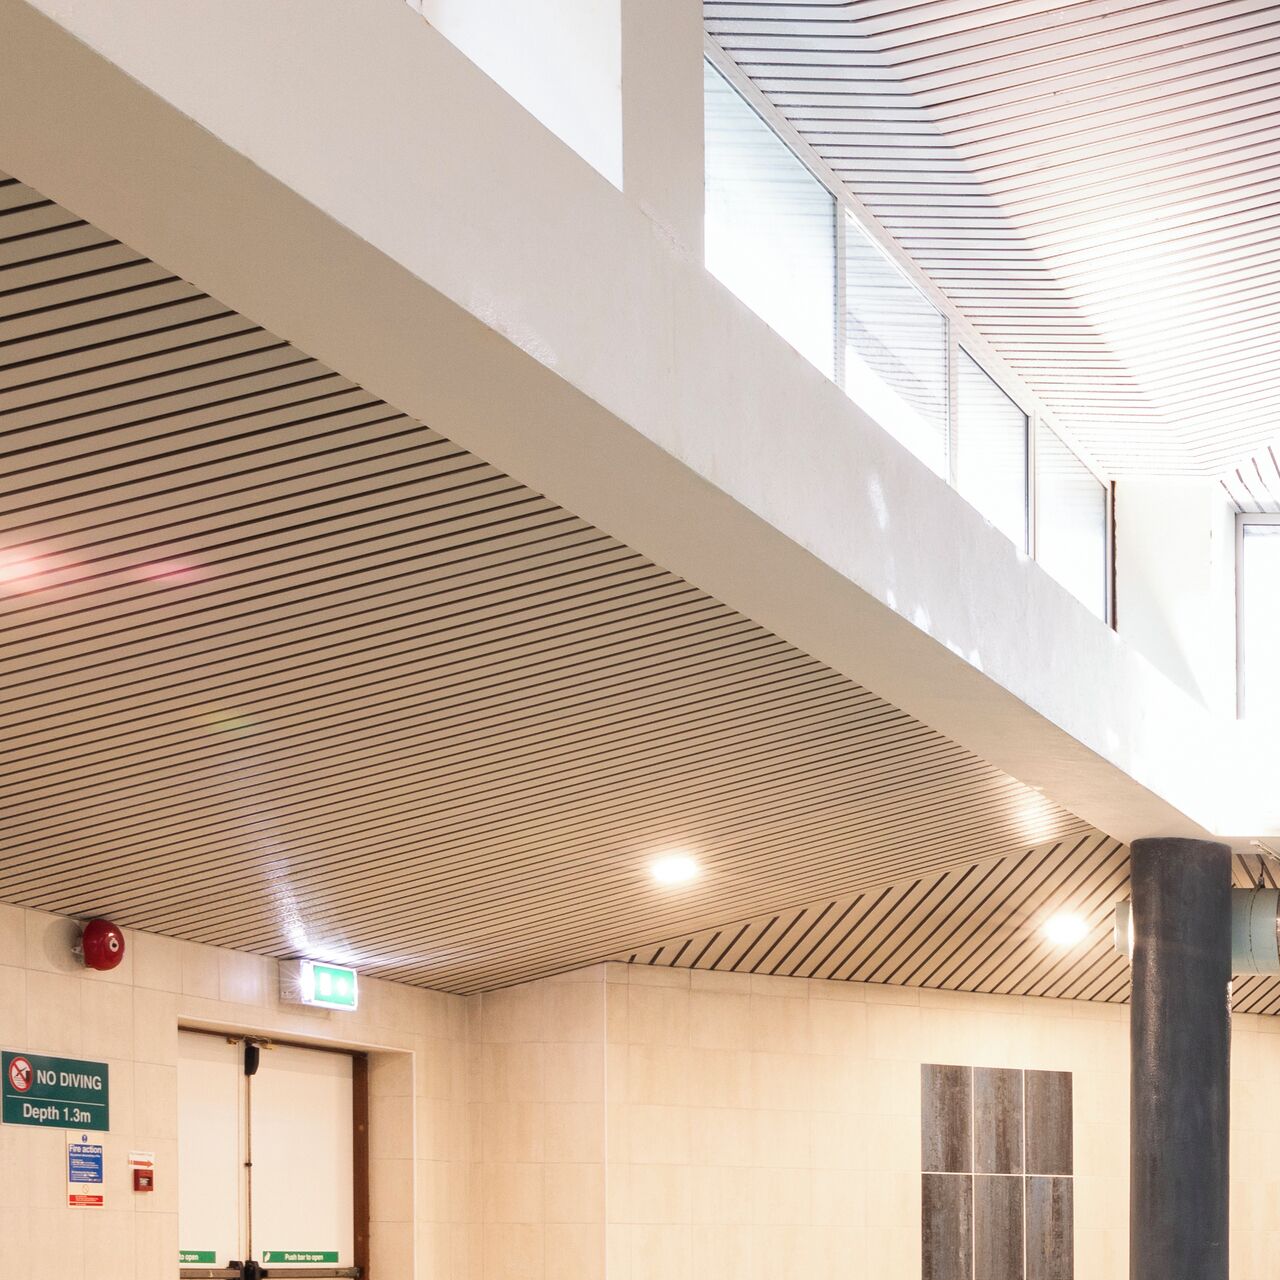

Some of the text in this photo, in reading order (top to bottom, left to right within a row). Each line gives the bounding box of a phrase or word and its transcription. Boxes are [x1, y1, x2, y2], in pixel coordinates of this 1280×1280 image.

[37, 1070, 102, 1090] NO DIVING
[23, 1103, 91, 1123] Depth 1.3m
[69, 1144, 102, 1154] Fire action
[185, 1254, 199, 1262] open
[284, 1253, 297, 1261] Push
[311, 1254, 324, 1262] open
